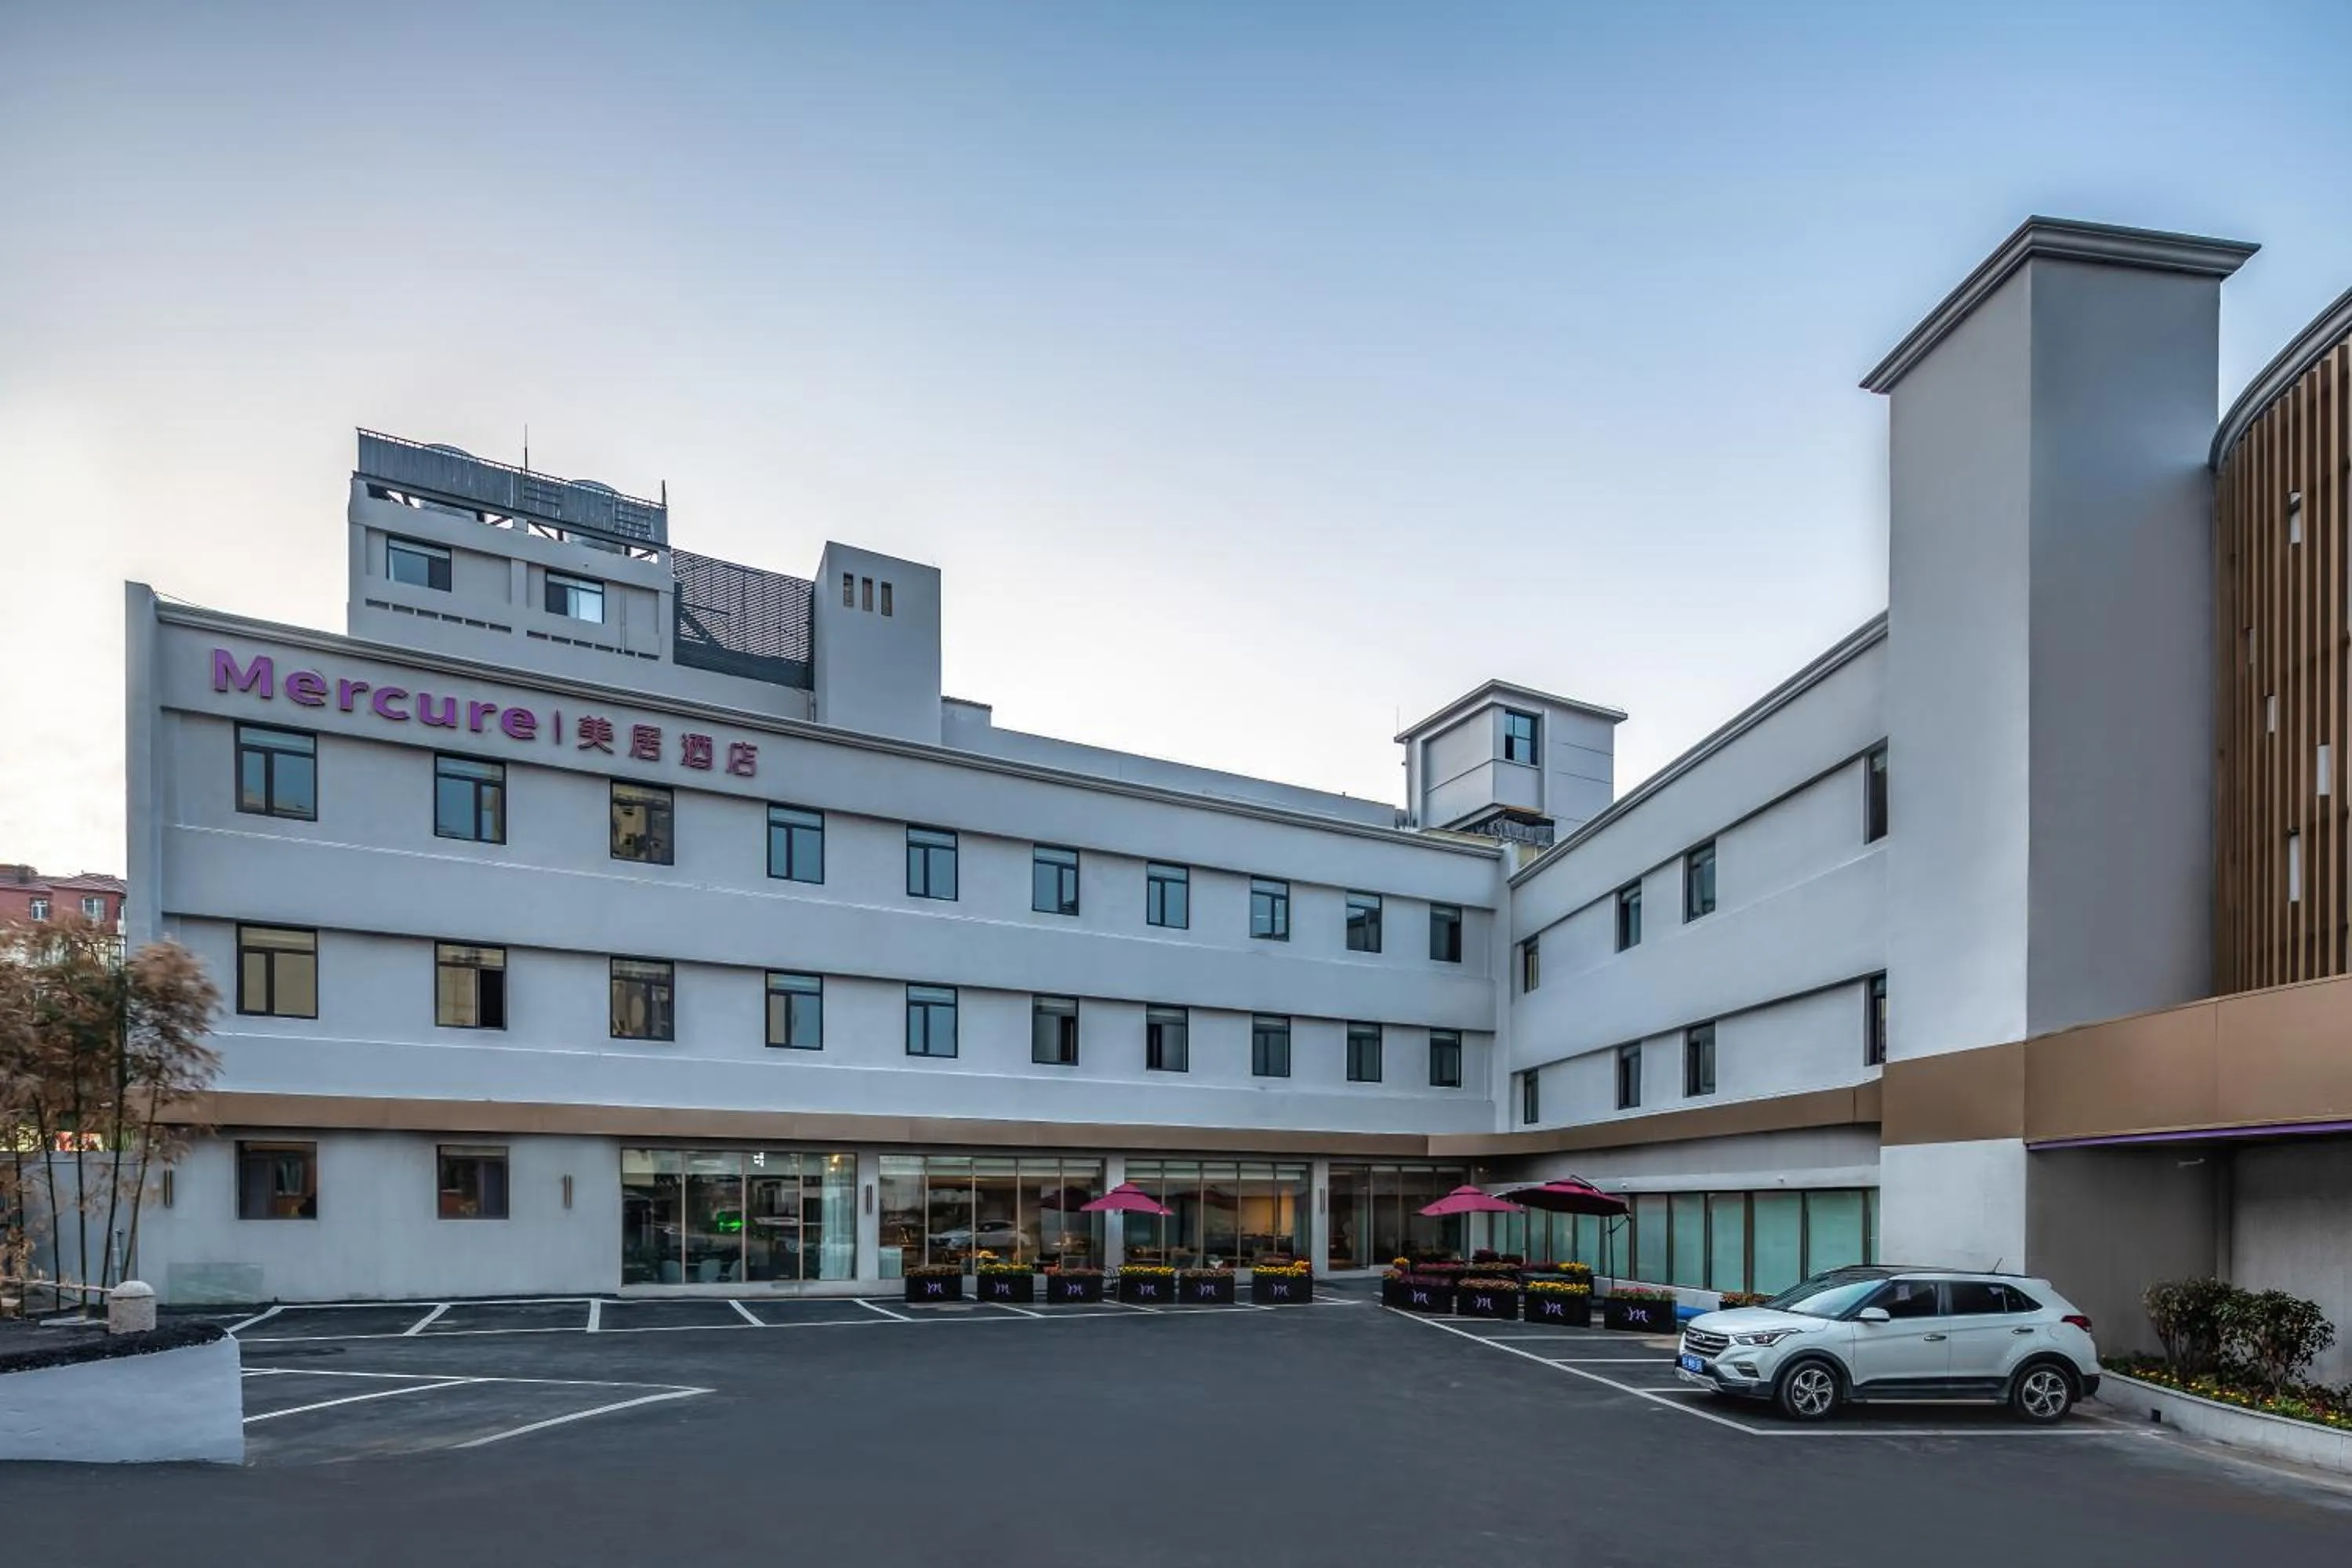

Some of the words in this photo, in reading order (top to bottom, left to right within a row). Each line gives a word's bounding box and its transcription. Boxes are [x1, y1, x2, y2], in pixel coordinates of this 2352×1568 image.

[212, 648, 541, 741] Mercure
[577, 715, 758, 778] 美居酒店
